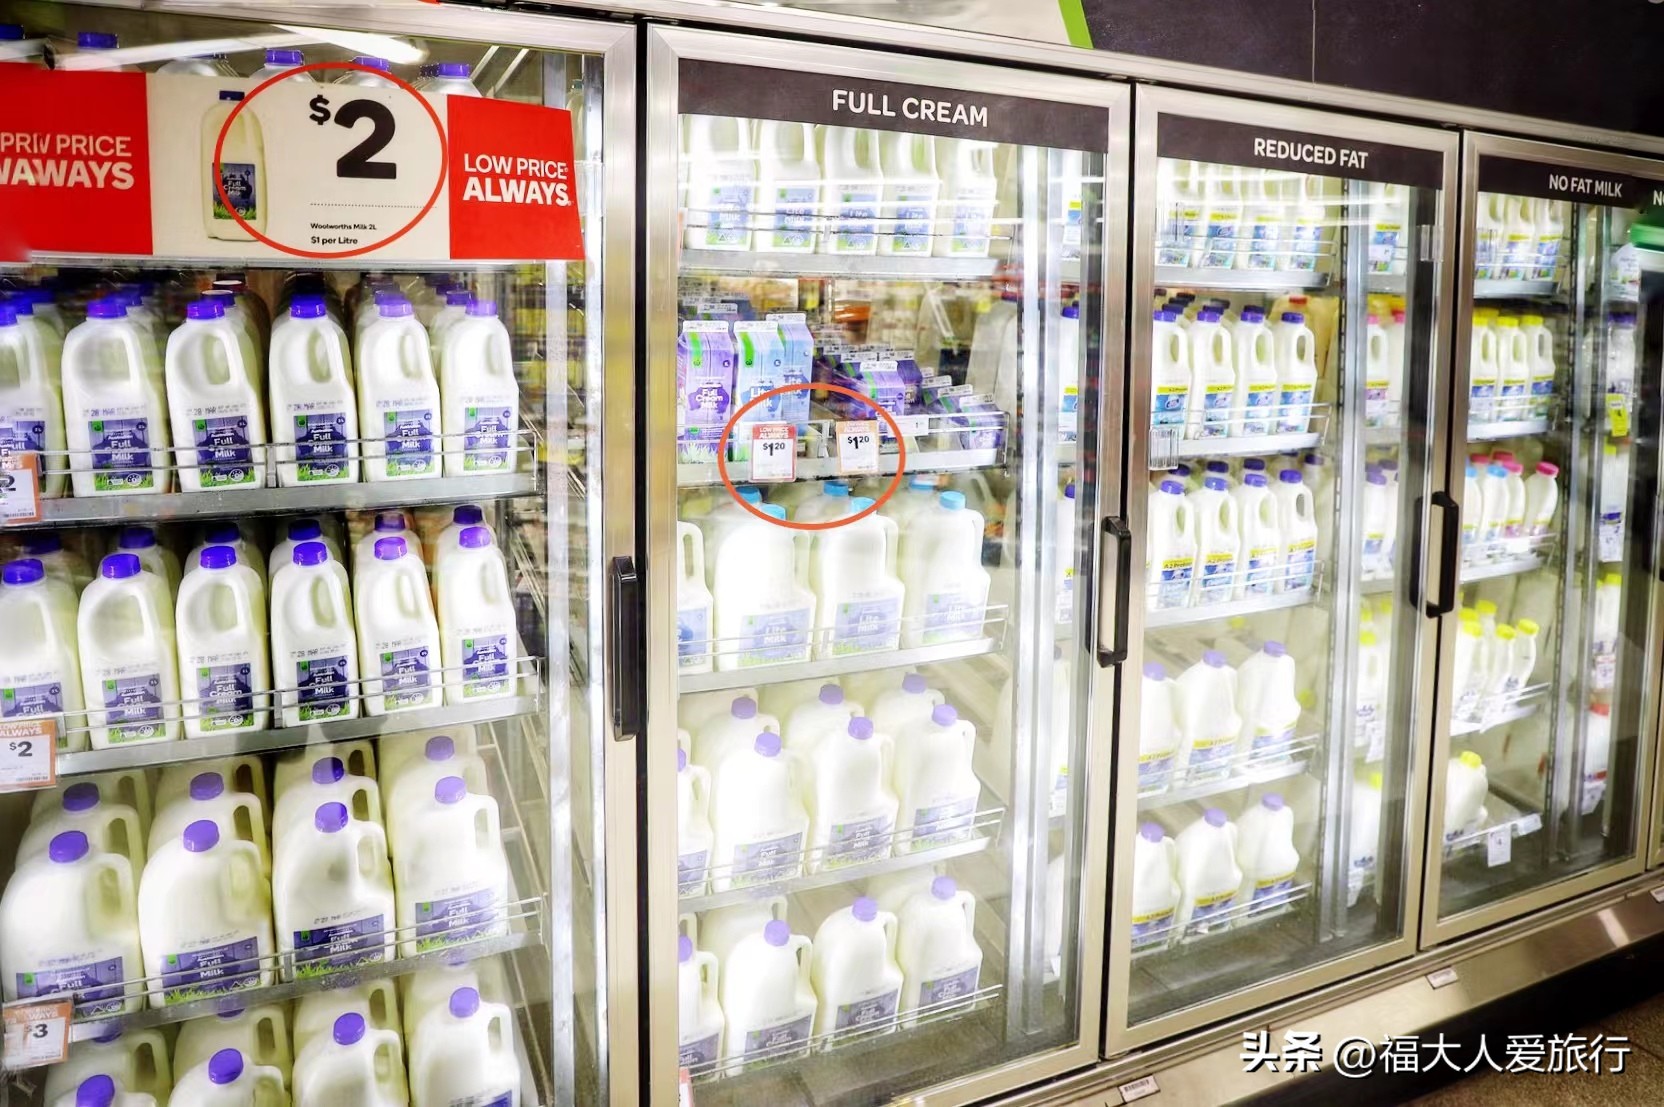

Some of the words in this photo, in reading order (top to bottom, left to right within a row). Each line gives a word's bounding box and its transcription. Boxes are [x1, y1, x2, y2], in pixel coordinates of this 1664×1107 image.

[832, 89, 896, 117] FULL
[902, 97, 988, 128] CREAM
[309, 94, 397, 180] $2
[55, 134, 132, 157] PRICE
[1253, 137, 1337, 165] REDUCED
[1339, 148, 1369, 169] FAT
[463, 153, 513, 175] LOW
[516, 157, 569, 180] PRICE
[1549, 173, 1568, 192] NO
[1570, 177, 1593, 194] FAT
[1594, 180, 1623, 198] MILK
[462, 176, 570, 207] ALWAYS
[1653, 189, 1664, 206] N
[310, 222, 352, 230] Woolworths
[353, 223, 367, 231] Milk
[368, 223, 377, 231] 2L
[310, 235, 321, 244] $1
[322, 236, 336, 246] per
[338, 236, 358, 245] Litre
[401, 428, 419, 436] Full
[480, 425, 498, 433] Full
[213, 437, 233, 446] Full
[312, 433, 332, 441] Full
[111, 440, 132, 448] Full
[312, 444, 333, 453] Milk
[401, 440, 421, 449] Milk
[111, 452, 134, 461] Milk
[214, 450, 236, 458] Milk
[314, 676, 333, 684] Full
[216, 684, 236, 693] Full
[315, 687, 335, 695] Milk
[123, 695, 144, 704] Full
[22, 705, 44, 714] Full
[124, 707, 146, 717] Milk
[449, 907, 468, 916] Full
[329, 945, 352, 953] Milk
[200, 959, 222, 968] Full
[200, 969, 224, 978] Milk
[58, 980, 83, 990] Full
